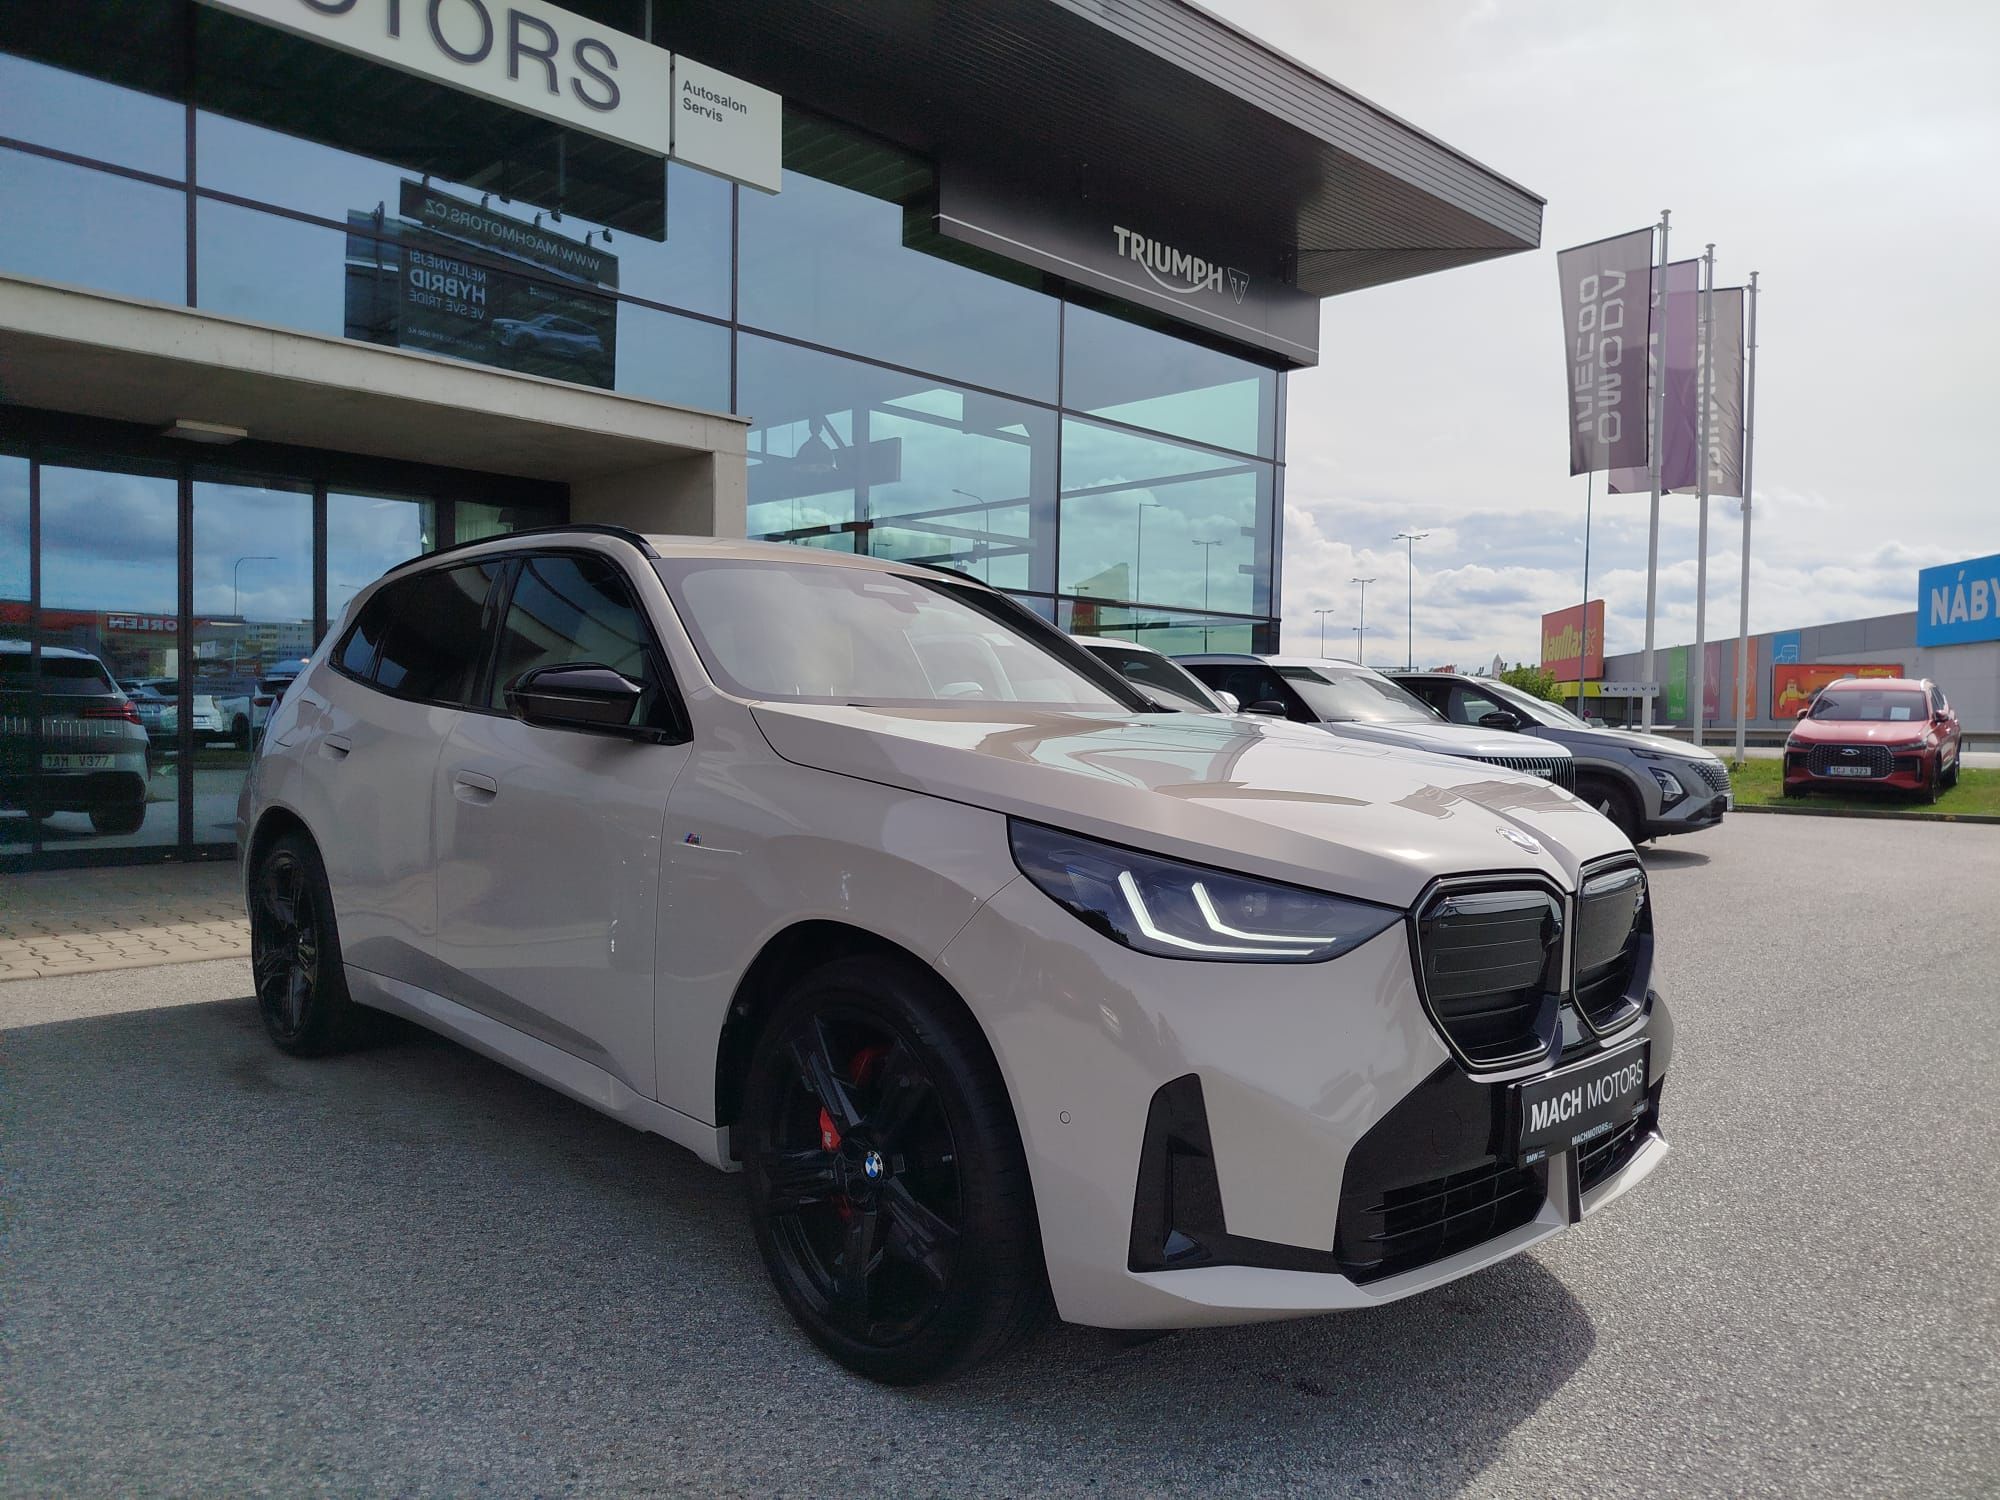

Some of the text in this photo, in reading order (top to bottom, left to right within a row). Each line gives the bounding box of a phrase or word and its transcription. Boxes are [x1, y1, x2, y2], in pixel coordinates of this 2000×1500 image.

[683, 80, 748, 115] Autosalon
[683, 97, 724, 122] Servis
[1113, 225, 1222, 293] TRIUMPH
[1530, 1058, 1644, 1133] MACH MOTORS
